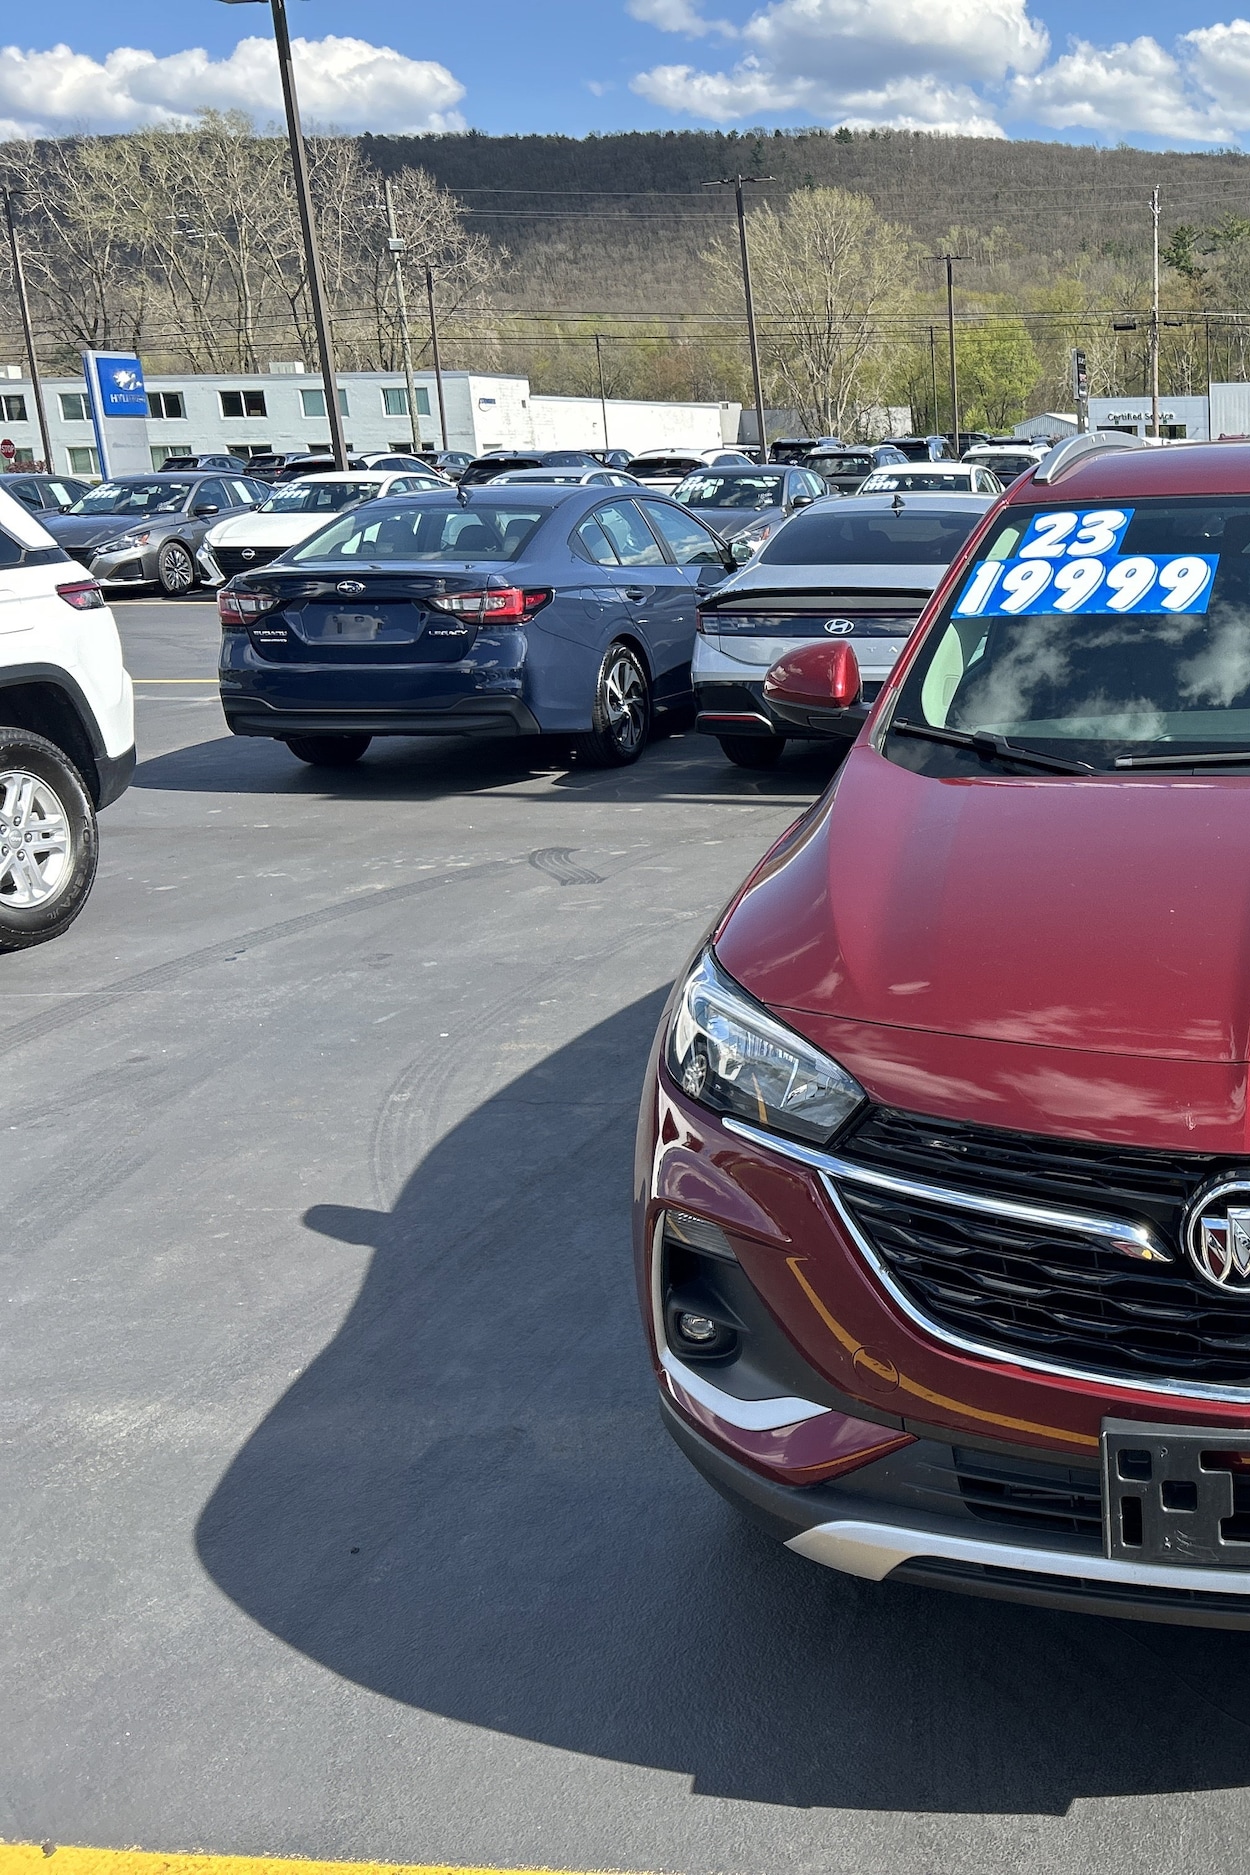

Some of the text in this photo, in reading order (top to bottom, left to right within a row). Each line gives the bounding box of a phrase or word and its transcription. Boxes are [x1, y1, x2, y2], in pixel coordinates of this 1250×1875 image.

[1107, 412, 1174, 421] Certified Sevice
[1018, 510, 1127, 558] 23
[957, 556, 1211, 616] 19999
